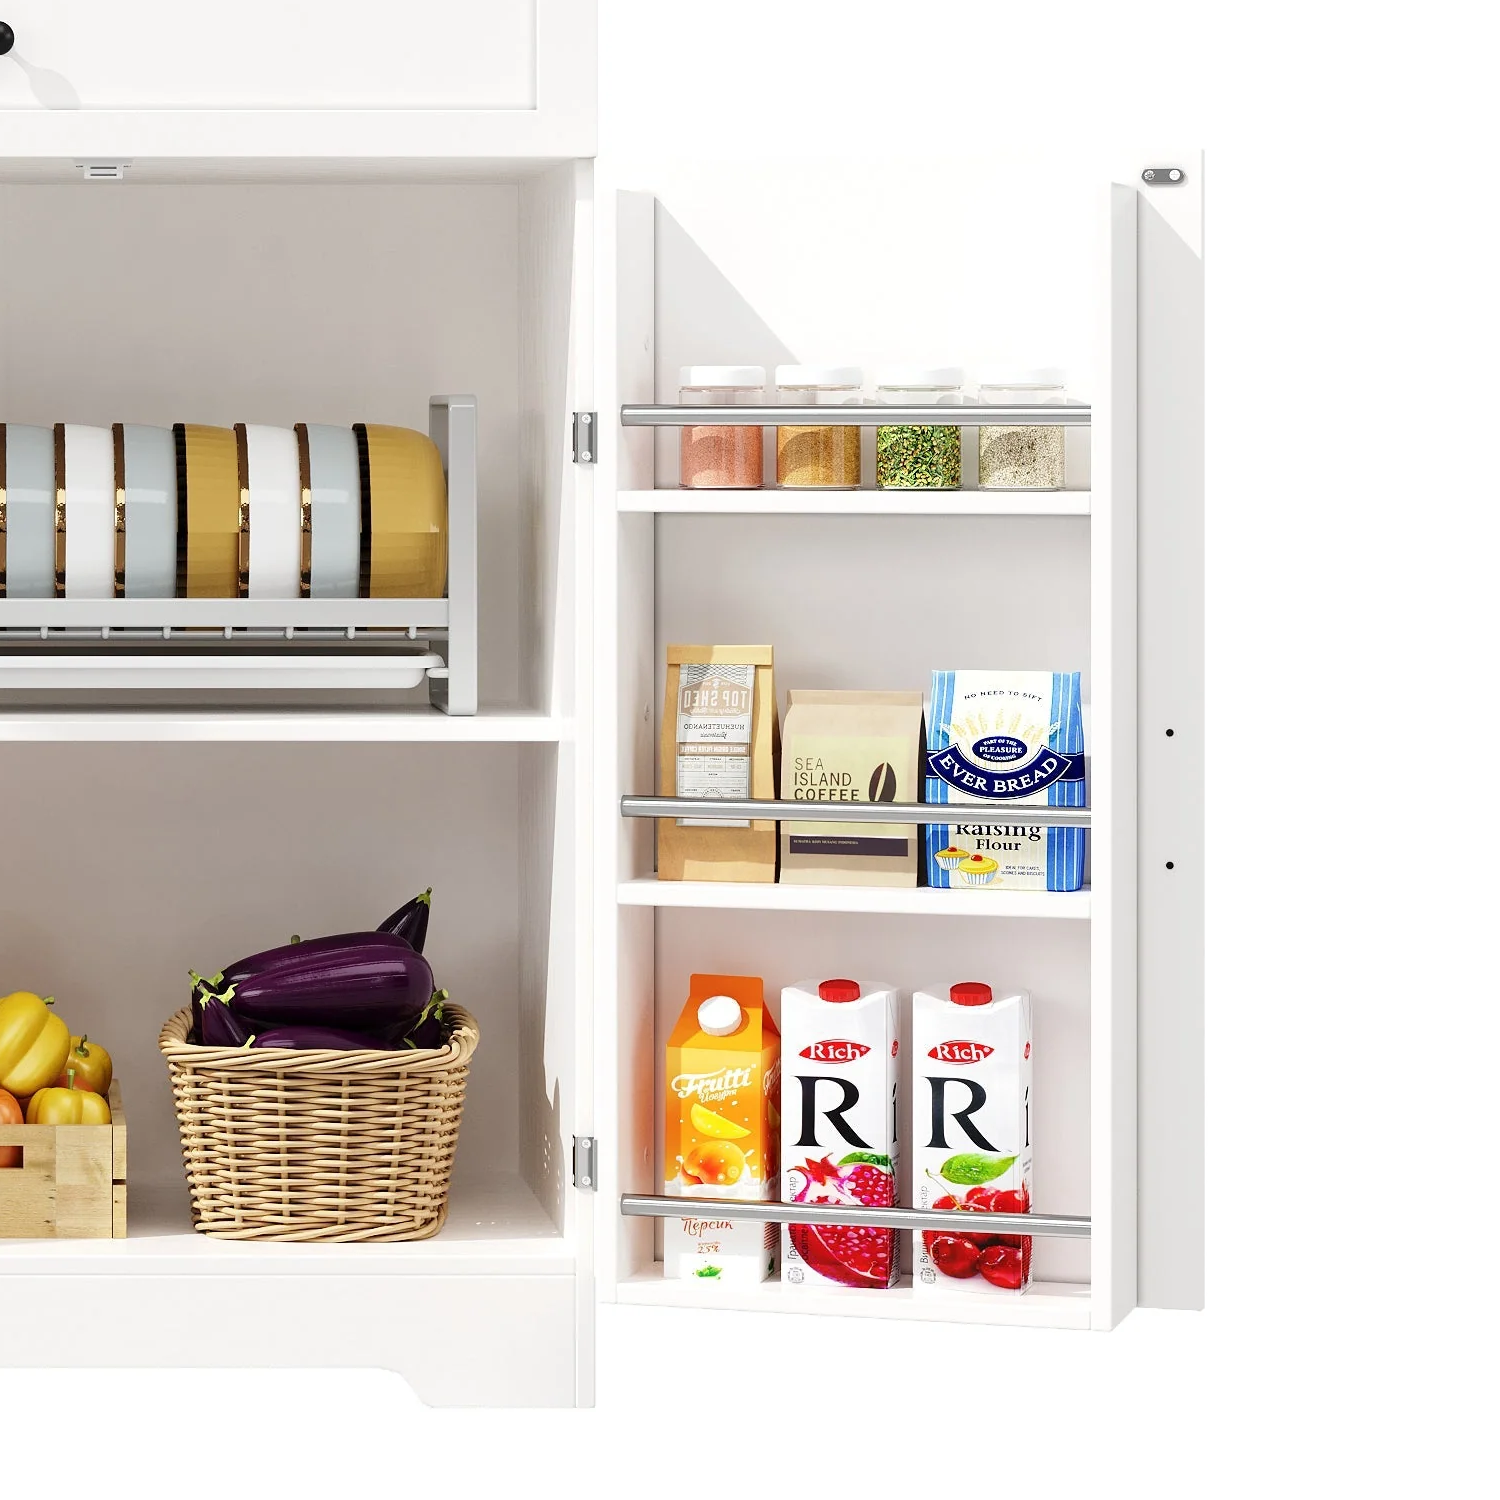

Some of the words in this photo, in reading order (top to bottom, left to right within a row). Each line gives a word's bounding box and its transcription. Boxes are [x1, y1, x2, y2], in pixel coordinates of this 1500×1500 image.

[1022, 692, 1042, 701] SIFT
[979, 746, 1023, 754] PLEASURE
[794, 757, 824, 771] SEA
[938, 753, 988, 792] EVER
[993, 757, 1058, 793] BREAD
[794, 772, 852, 786] ISLAND
[794, 788, 860, 801] COFFEE
[955, 824, 1042, 842] Raising
[975, 838, 1022, 851] Flour
[809, 1043, 861, 1060] Rich
[935, 1043, 985, 1061] Rich
[671, 1066, 753, 1099] Frutti
[790, 1075, 875, 1150] R
[920, 1076, 1002, 1152] R
[789, 1176, 797, 1202] ектар
[680, 1216, 733, 1238] Персик
